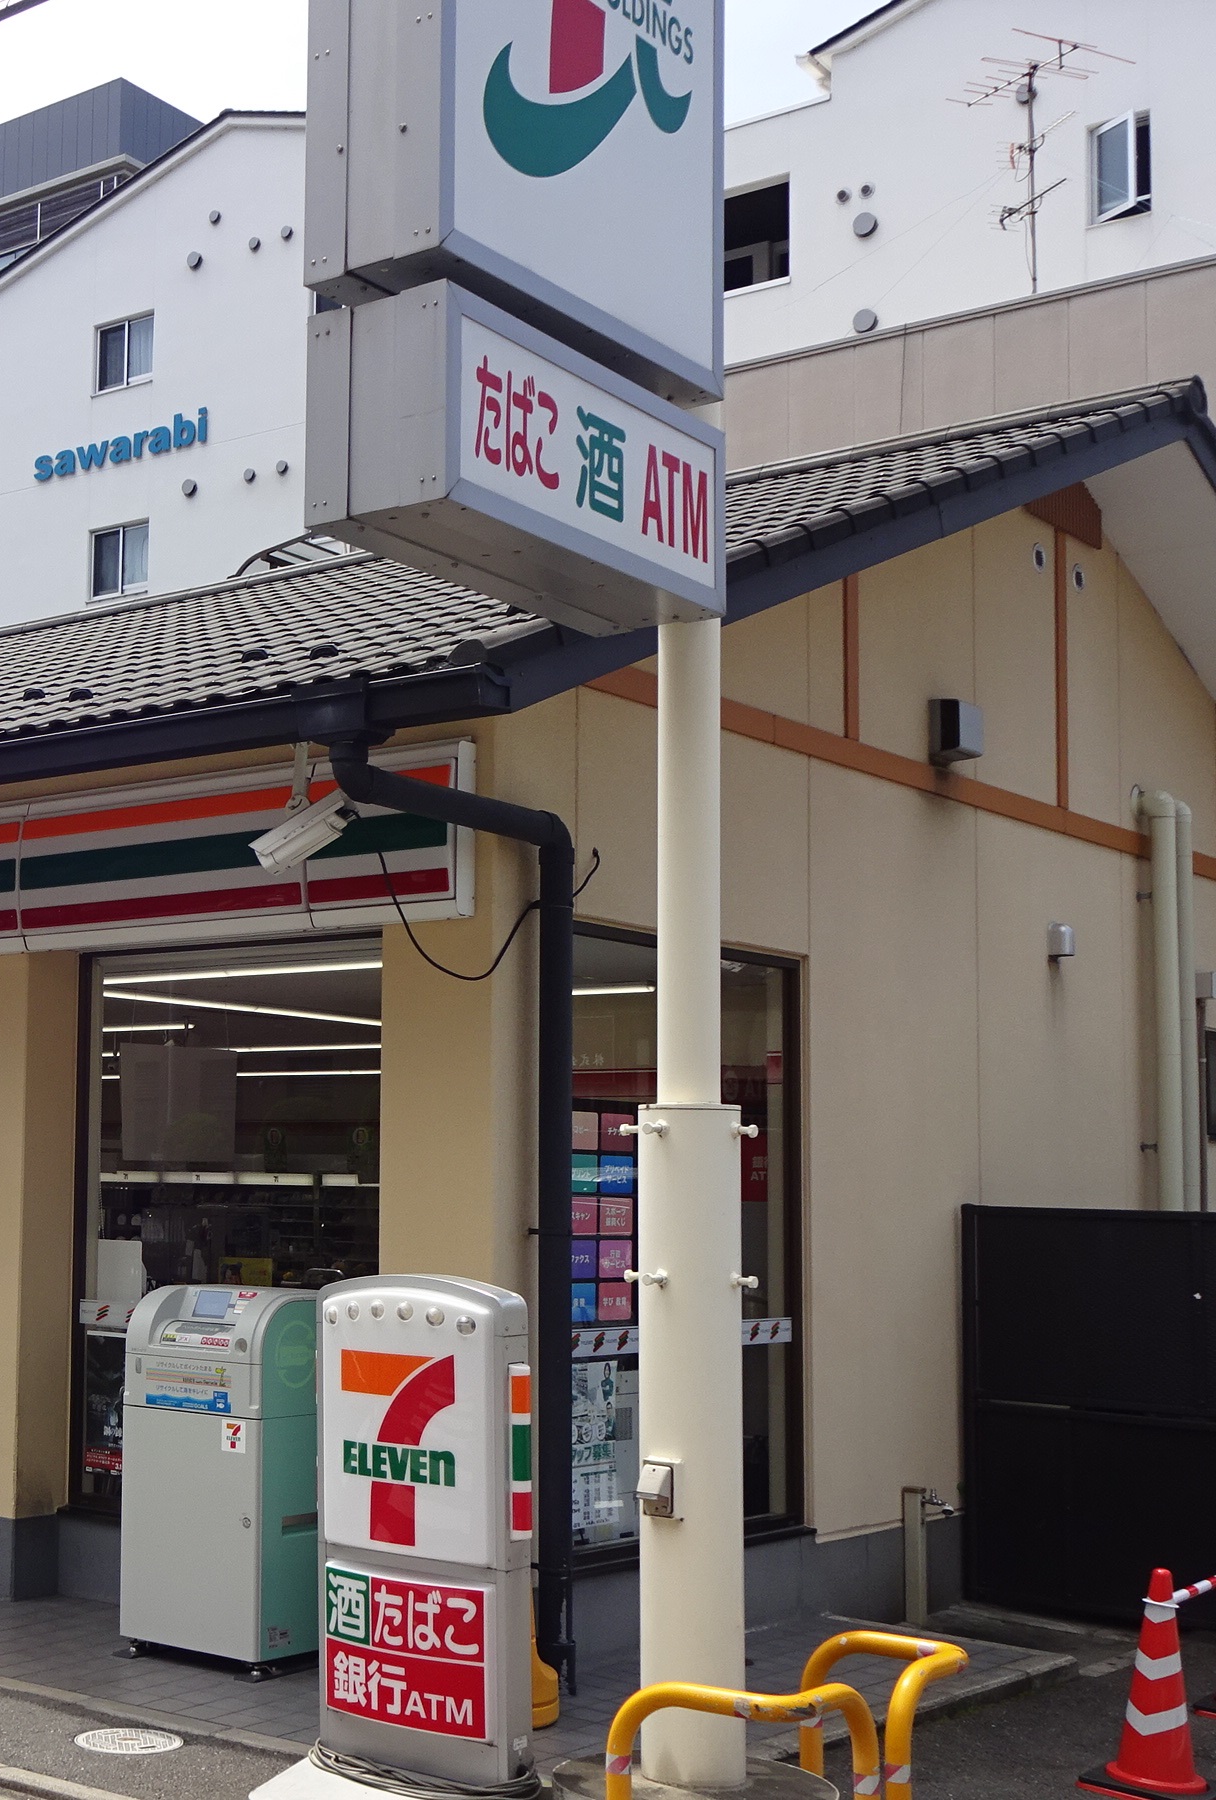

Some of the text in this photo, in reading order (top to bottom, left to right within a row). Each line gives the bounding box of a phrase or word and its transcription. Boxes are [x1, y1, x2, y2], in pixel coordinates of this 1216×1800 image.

[607, 0, 694, 65] LDINGS
[34, 406, 208, 481] sawarabi
[475, 355, 708, 564] たばこ 酒 ATM
[572, 1442, 616, 1464] タッフ募集!
[328, 1575, 480, 1658] 酒 たばこ
